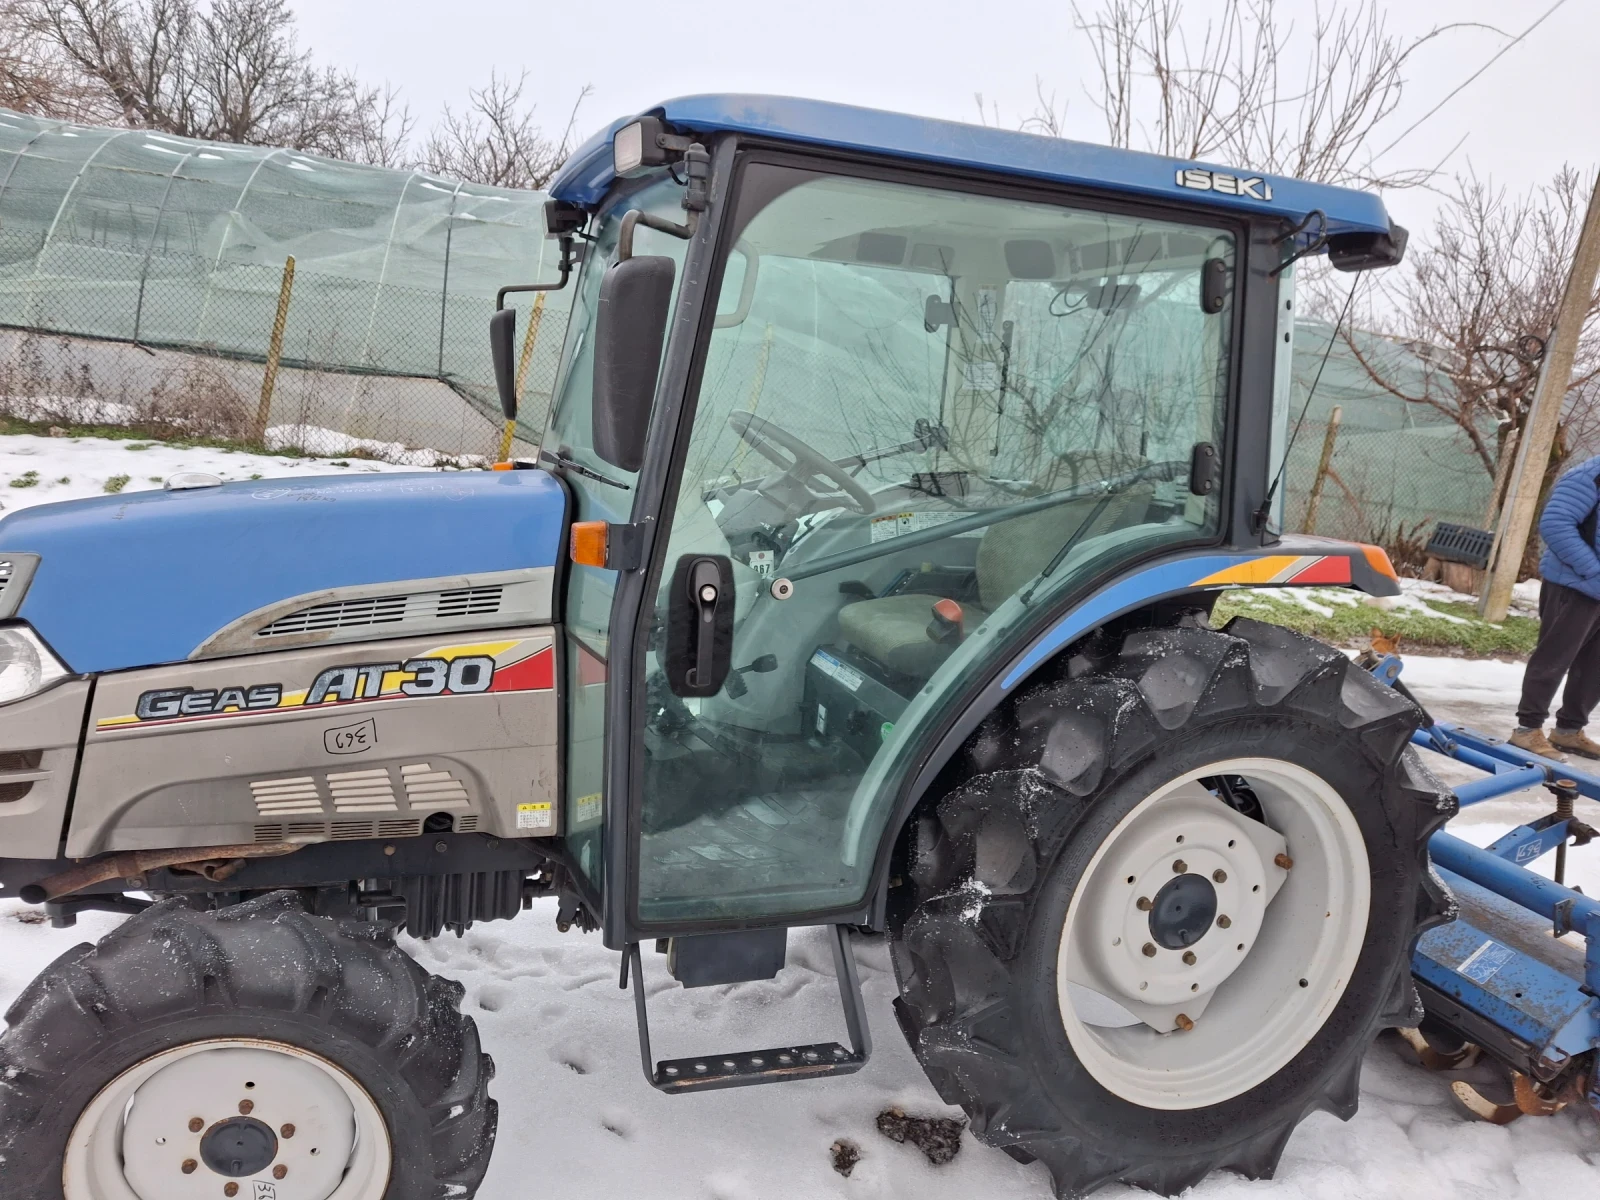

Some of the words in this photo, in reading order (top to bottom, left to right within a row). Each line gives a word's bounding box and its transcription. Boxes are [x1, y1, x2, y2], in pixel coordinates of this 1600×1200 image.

[1176, 168, 1273, 200] ISEKI
[136, 683, 282, 719] GEAS
[302, 655, 495, 705] AT30
[335, 726, 367, 749] 367
